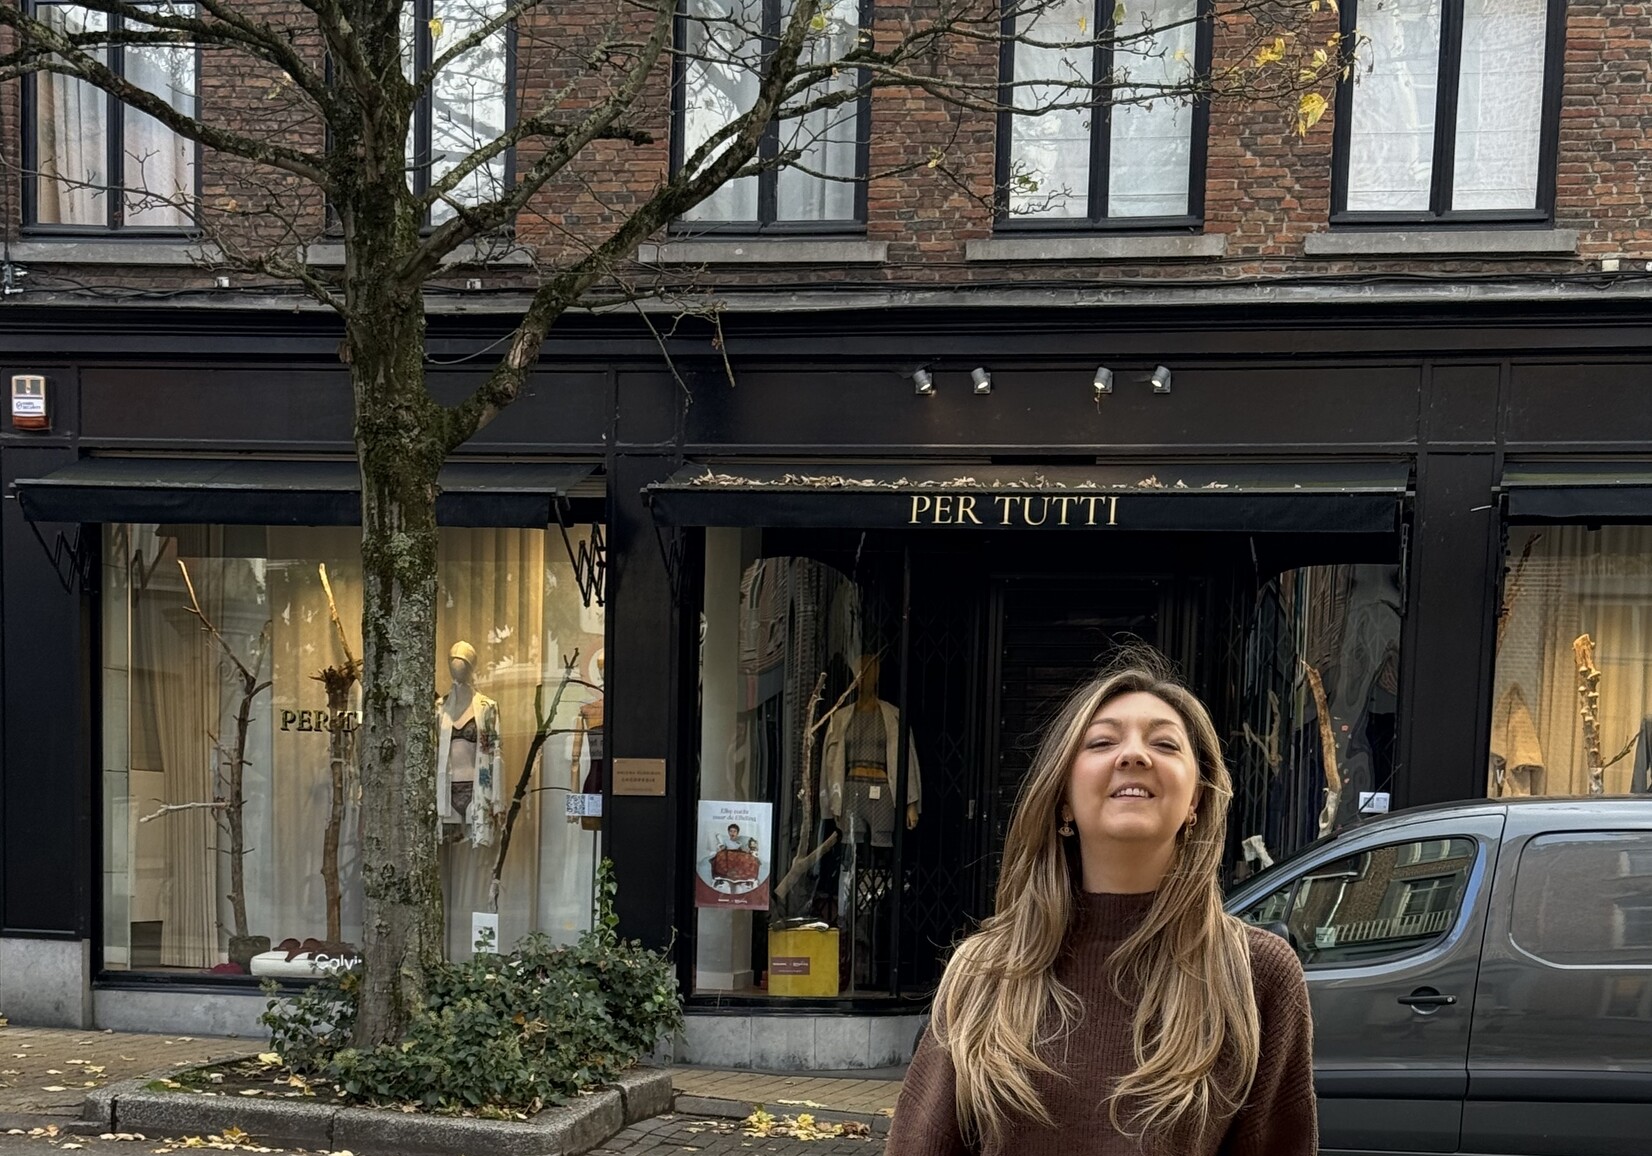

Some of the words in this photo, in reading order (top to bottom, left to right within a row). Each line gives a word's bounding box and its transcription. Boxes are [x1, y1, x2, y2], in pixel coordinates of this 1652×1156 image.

[908, 495, 983, 525] PER
[994, 496, 1120, 526] TUTTI
[280, 709, 333, 732] PER
[315, 953, 363, 971] Calvi
